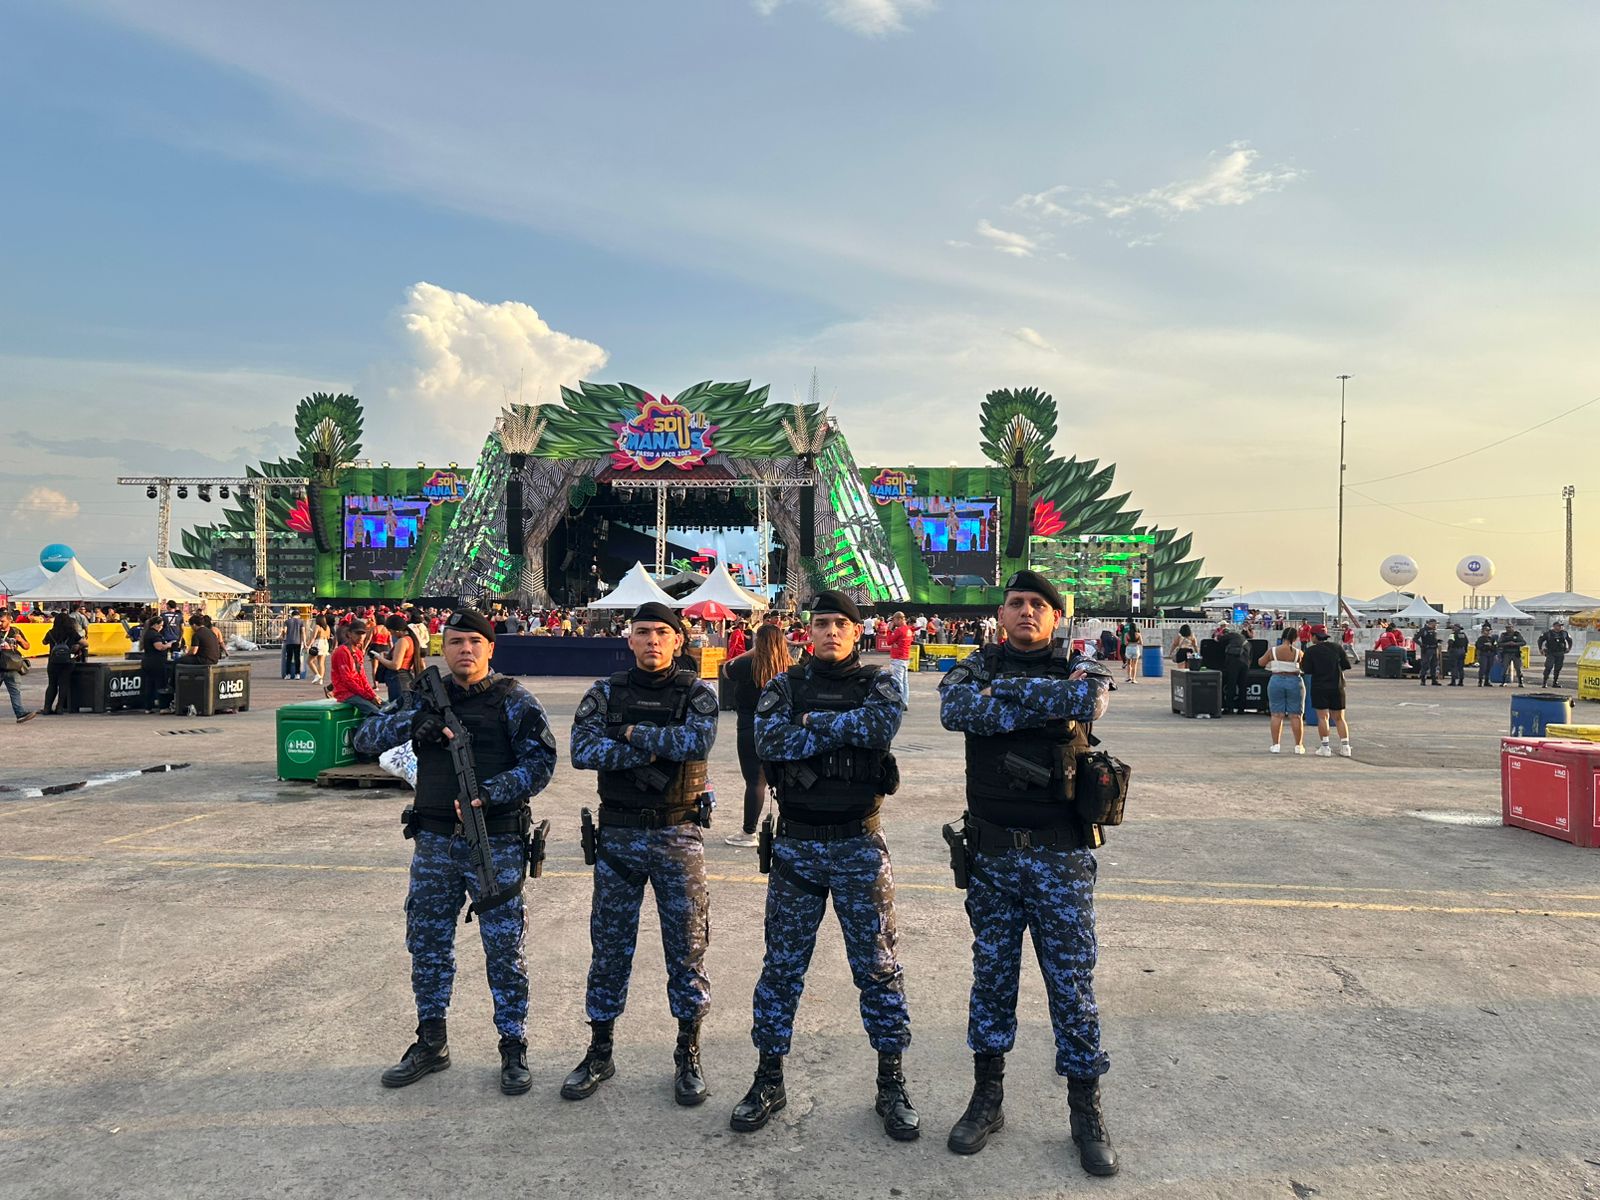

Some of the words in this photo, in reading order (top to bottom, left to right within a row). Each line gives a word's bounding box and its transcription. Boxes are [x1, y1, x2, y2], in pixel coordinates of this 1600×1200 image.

[627, 432, 702, 449] MANAUS
[120, 676, 142, 690] H2O
[226, 679, 244, 692] H2O
[295, 740, 315, 749] H2O
